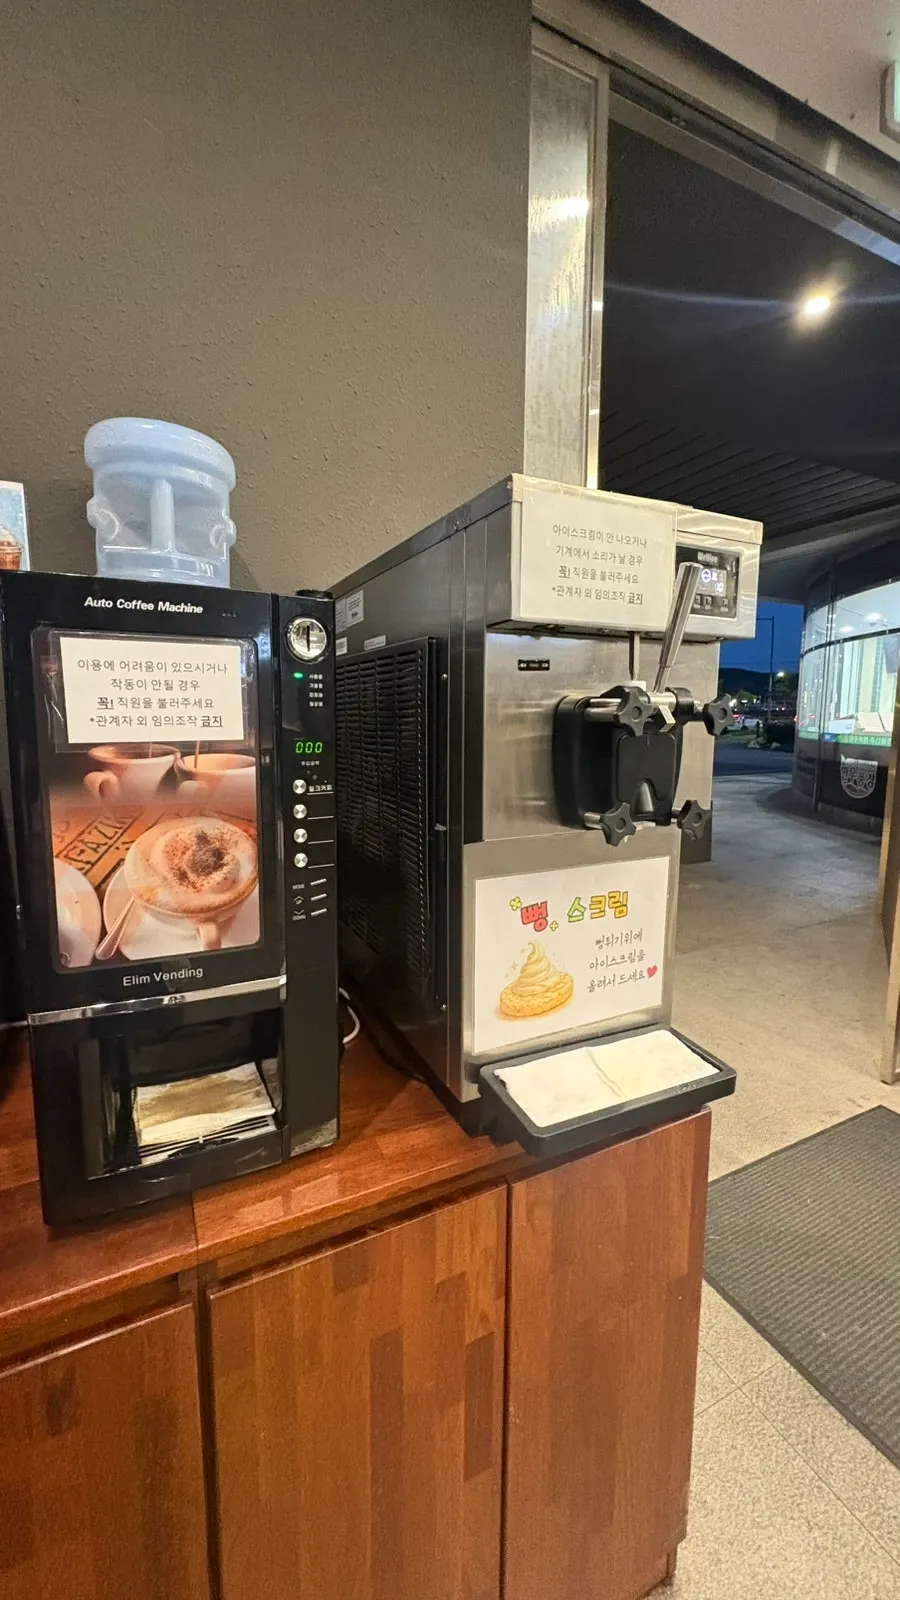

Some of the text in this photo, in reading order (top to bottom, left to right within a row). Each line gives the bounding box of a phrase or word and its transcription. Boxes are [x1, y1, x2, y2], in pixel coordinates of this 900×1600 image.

[553, 524, 648, 549] 아이스크림이 안 나오거나
[555, 545, 644, 567] 기계에서 소리가 날 경우
[558, 565, 639, 585] 꼭! 직원을 불러주세요
[84, 596, 204, 614] Auto Coffee Machine
[584, 587, 592, 599] 외
[594, 589, 626, 603] 임의조작
[627, 592, 644, 605] 금지
[77, 659, 228, 675] 이용에 어려움이 있으시거나
[111, 678, 201, 691] 작동이 안될 경우
[97, 697, 214, 710] 꼭! 직원을 불러주세요
[136, 715, 148, 727] 외
[152, 715, 198, 728] 임의조작
[200, 715, 224, 728] 금지
[295, 741, 323, 754] 000
[520, 890, 629, 933] 뻥 스크림
[594, 928, 644, 951] 뻥튀기위에
[589, 949, 647, 971] 아이스크림을
[122, 967, 204, 987] Elim Vending
[586, 969, 646, 994] 올려서 드세요
